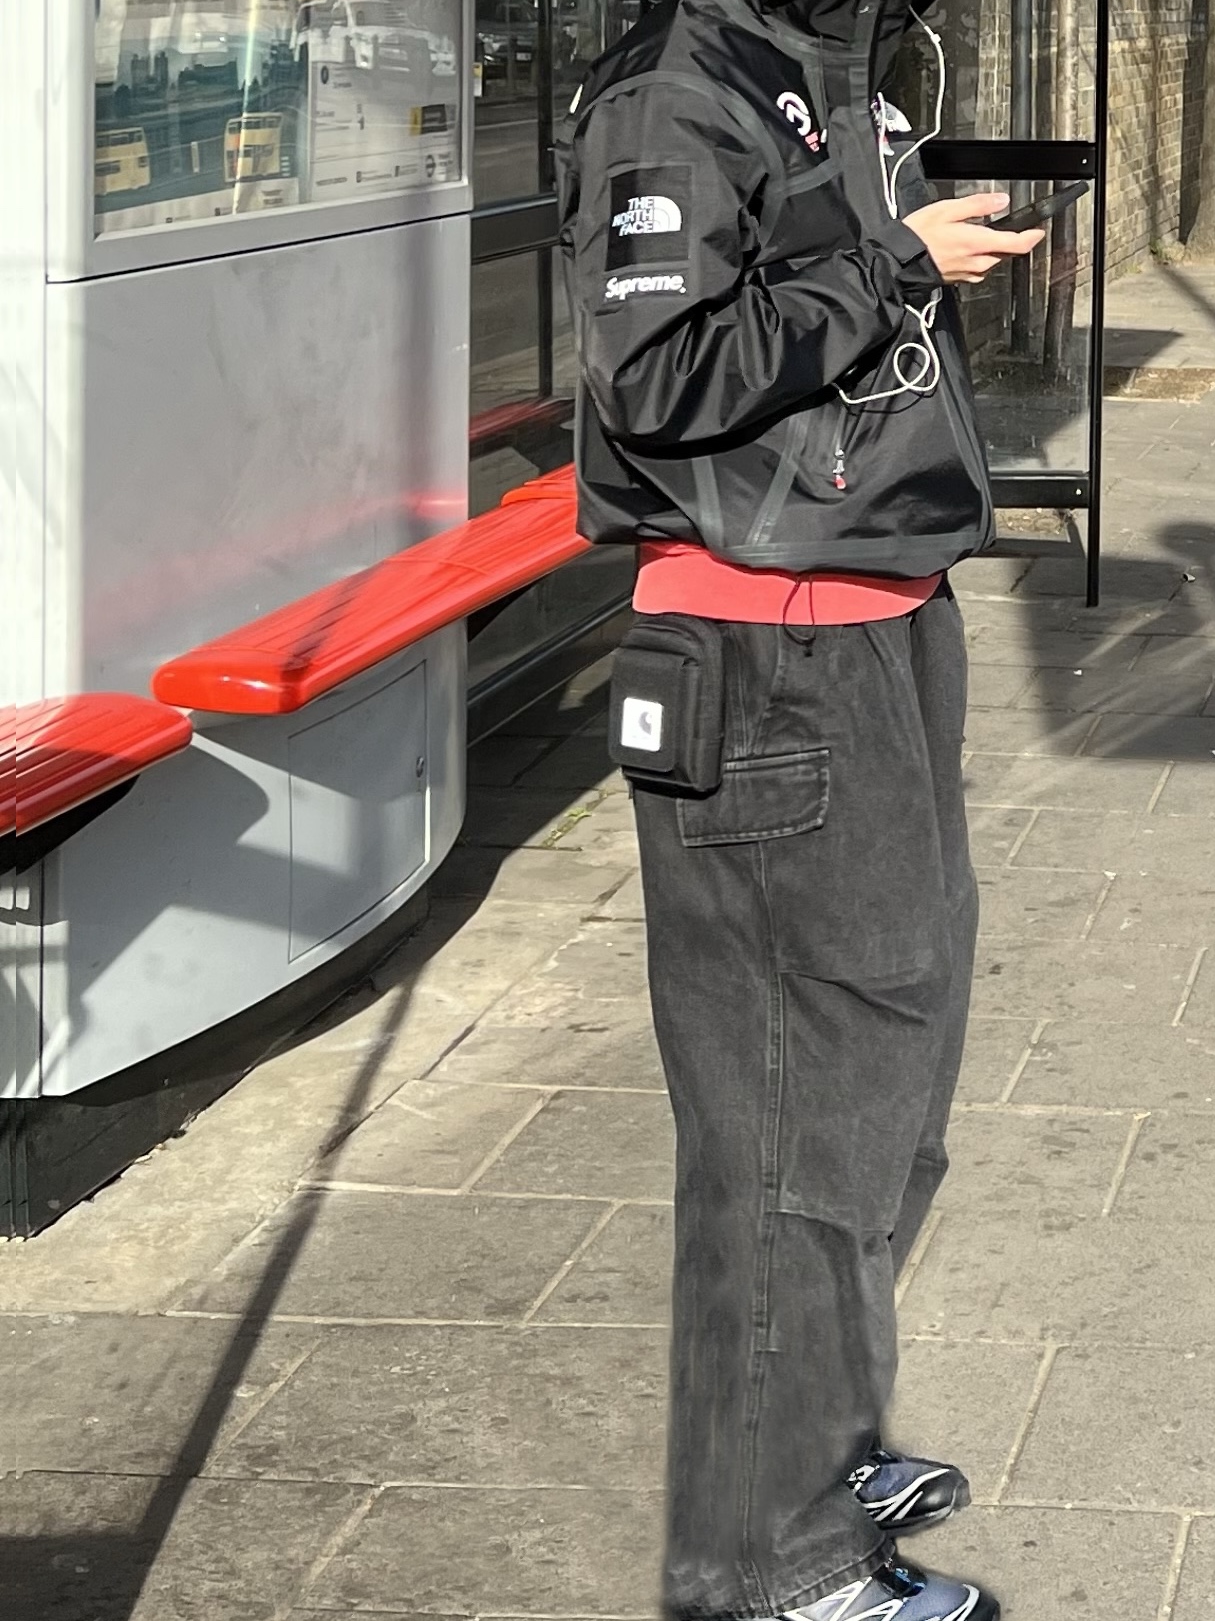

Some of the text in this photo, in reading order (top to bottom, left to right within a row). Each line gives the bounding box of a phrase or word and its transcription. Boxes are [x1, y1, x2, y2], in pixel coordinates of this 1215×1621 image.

[628, 196, 654, 210] THE
[612, 209, 653, 227] NORTH
[619, 220, 654, 237] FACE
[605, 275, 686, 300] Supreme
